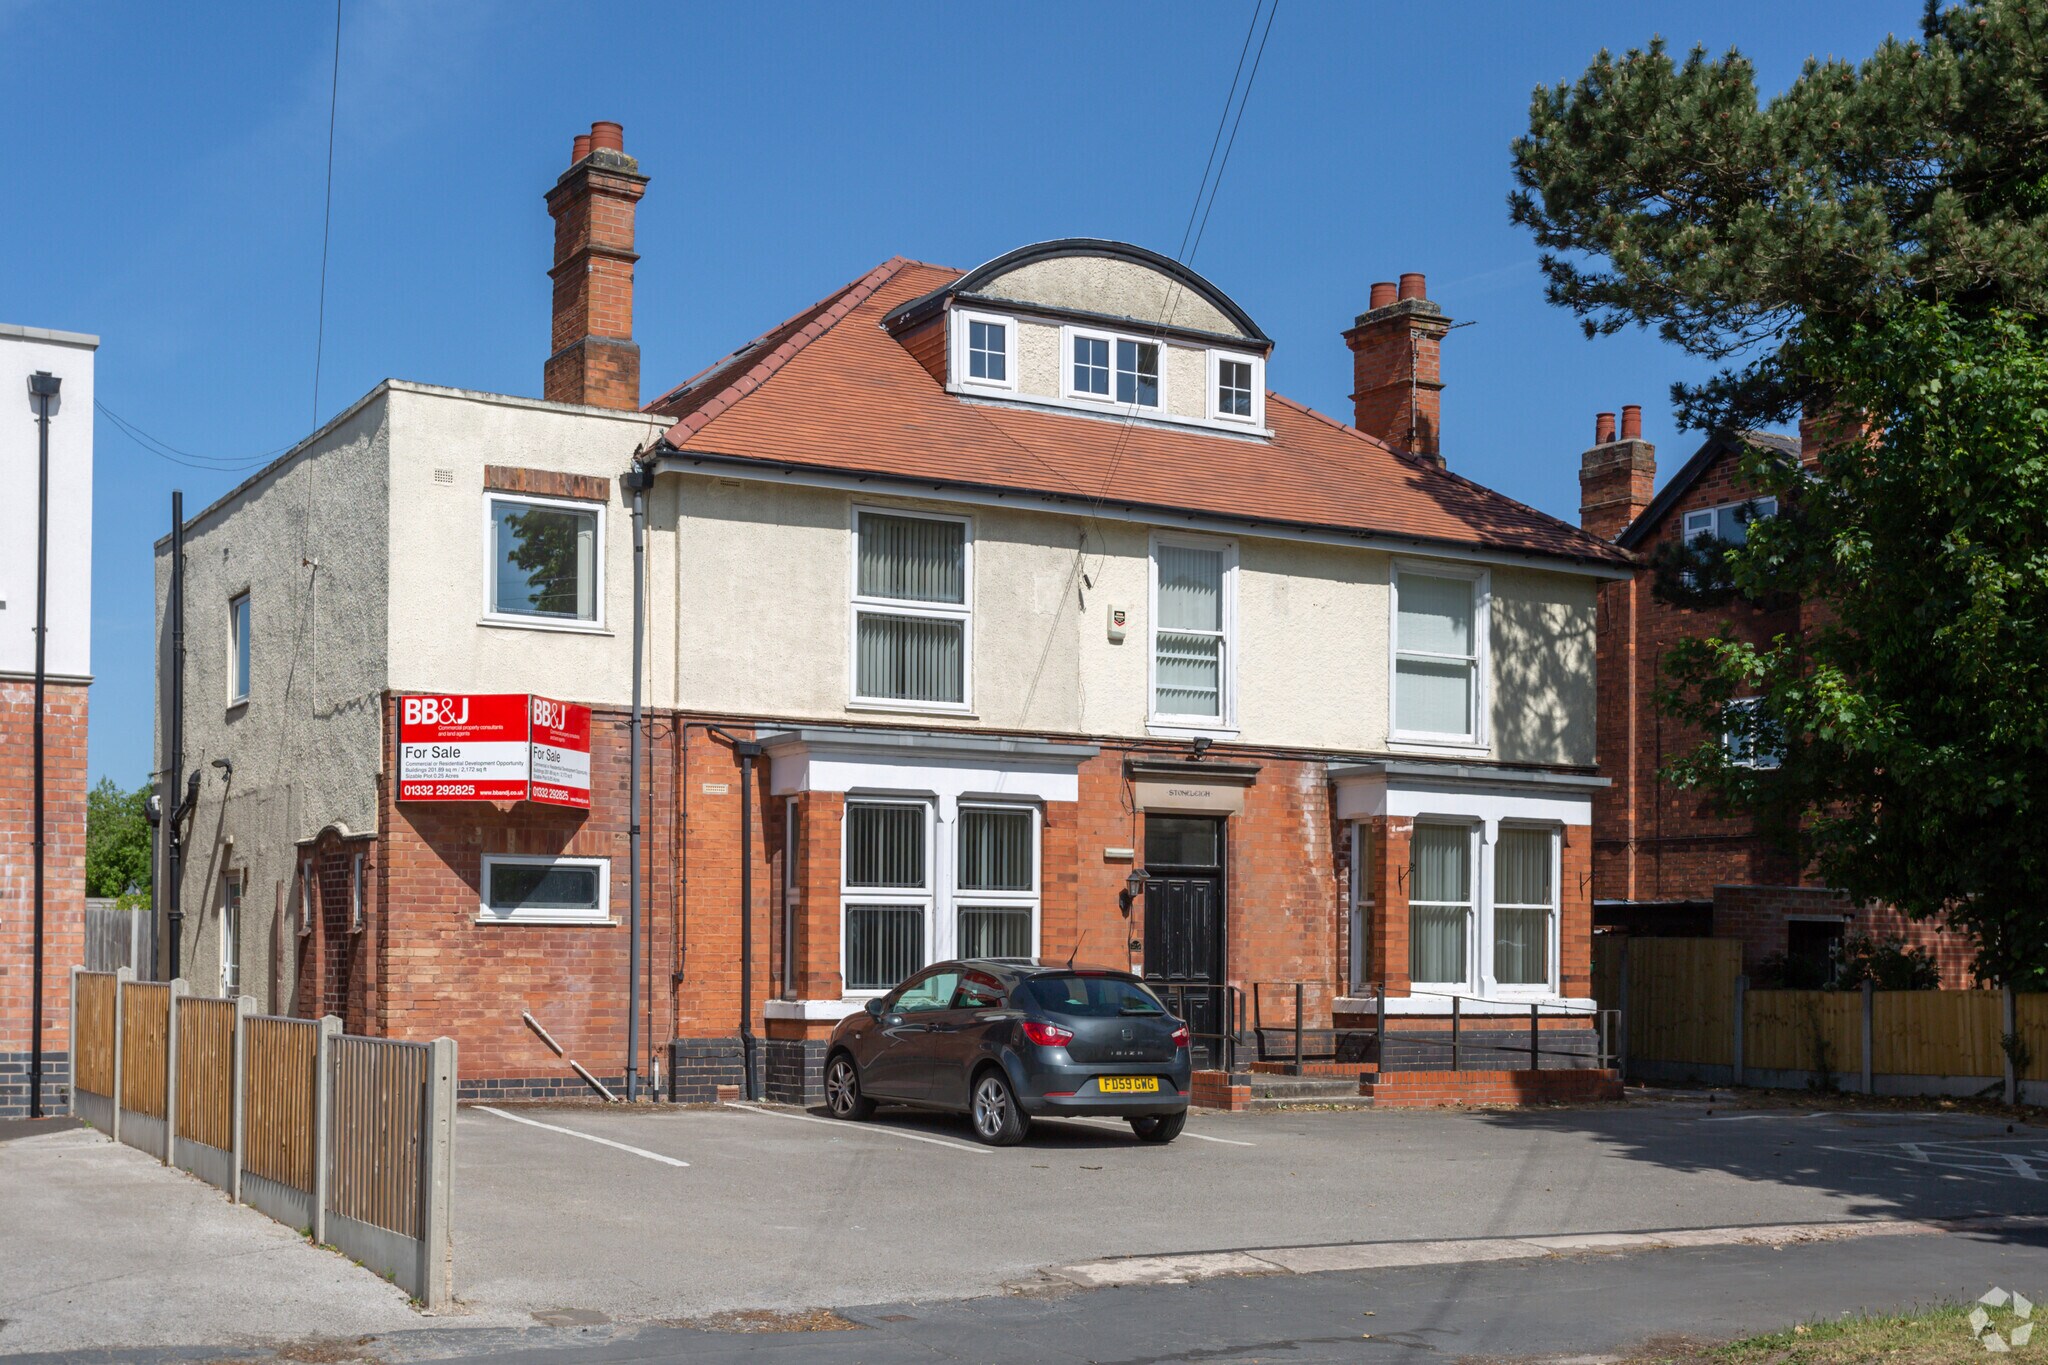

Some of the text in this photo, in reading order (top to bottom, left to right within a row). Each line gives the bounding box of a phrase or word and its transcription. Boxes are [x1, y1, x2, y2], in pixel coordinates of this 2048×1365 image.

[404, 698, 468, 725] BB&J
[534, 698, 566, 730] BB&J
[406, 746, 460, 758] For Sale
[534, 746, 560, 762] For Sale
[404, 785, 475, 795] 01332 292825
[533, 786, 548, 798] 01332
[1104, 1078, 1154, 1090] FD59 GWG
